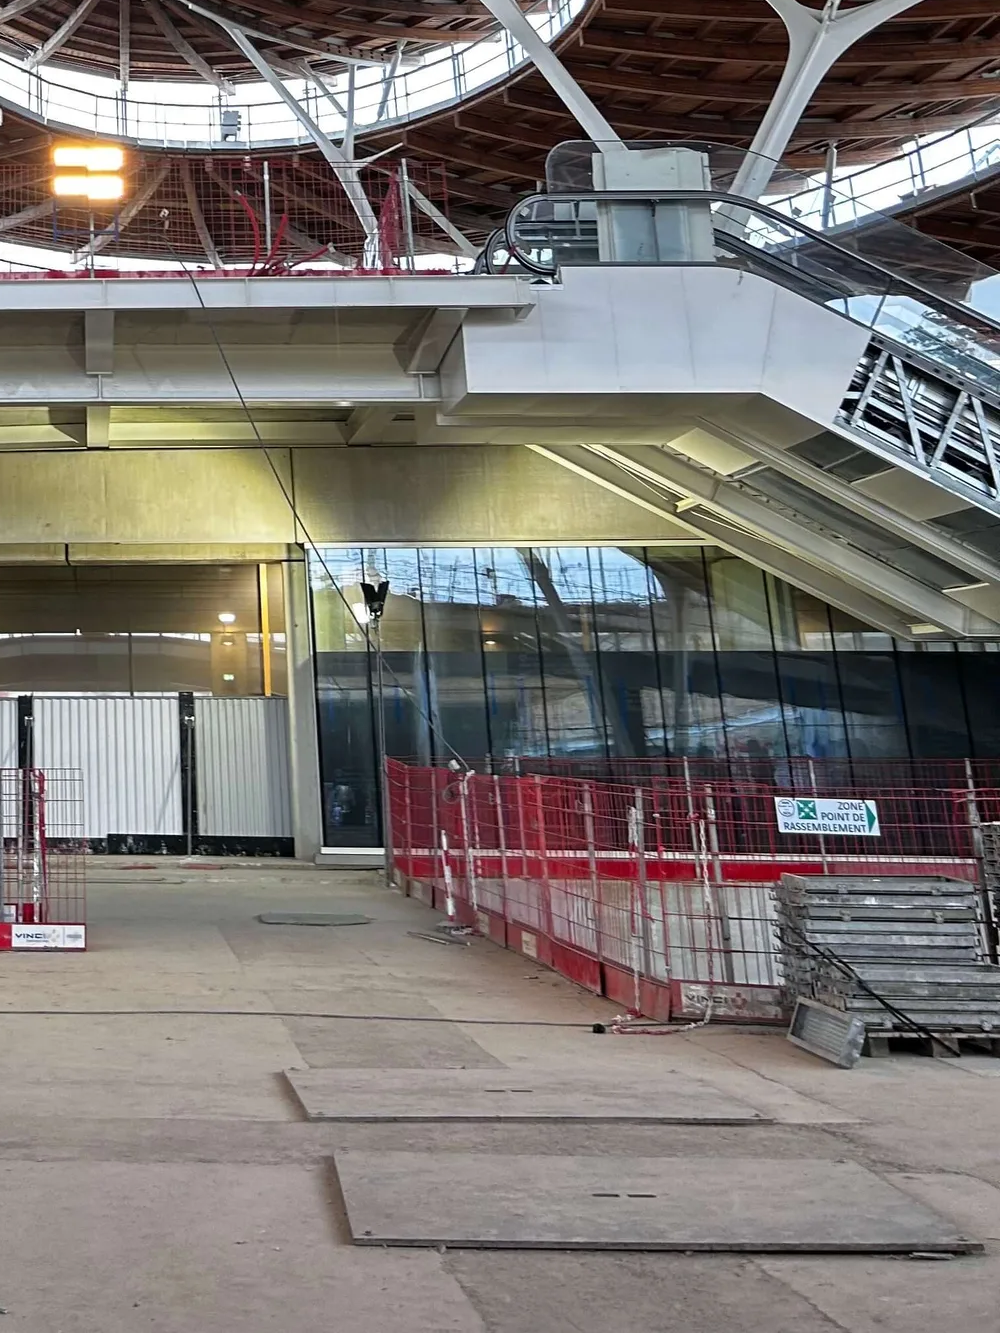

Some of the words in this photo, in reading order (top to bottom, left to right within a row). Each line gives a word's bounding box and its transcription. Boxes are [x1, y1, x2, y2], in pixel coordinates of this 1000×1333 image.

[837, 801, 864, 811] ZONE
[821, 812, 851, 822] POINT
[852, 813, 866, 822] DE
[784, 821, 867, 833] RASSEMBLEMENT
